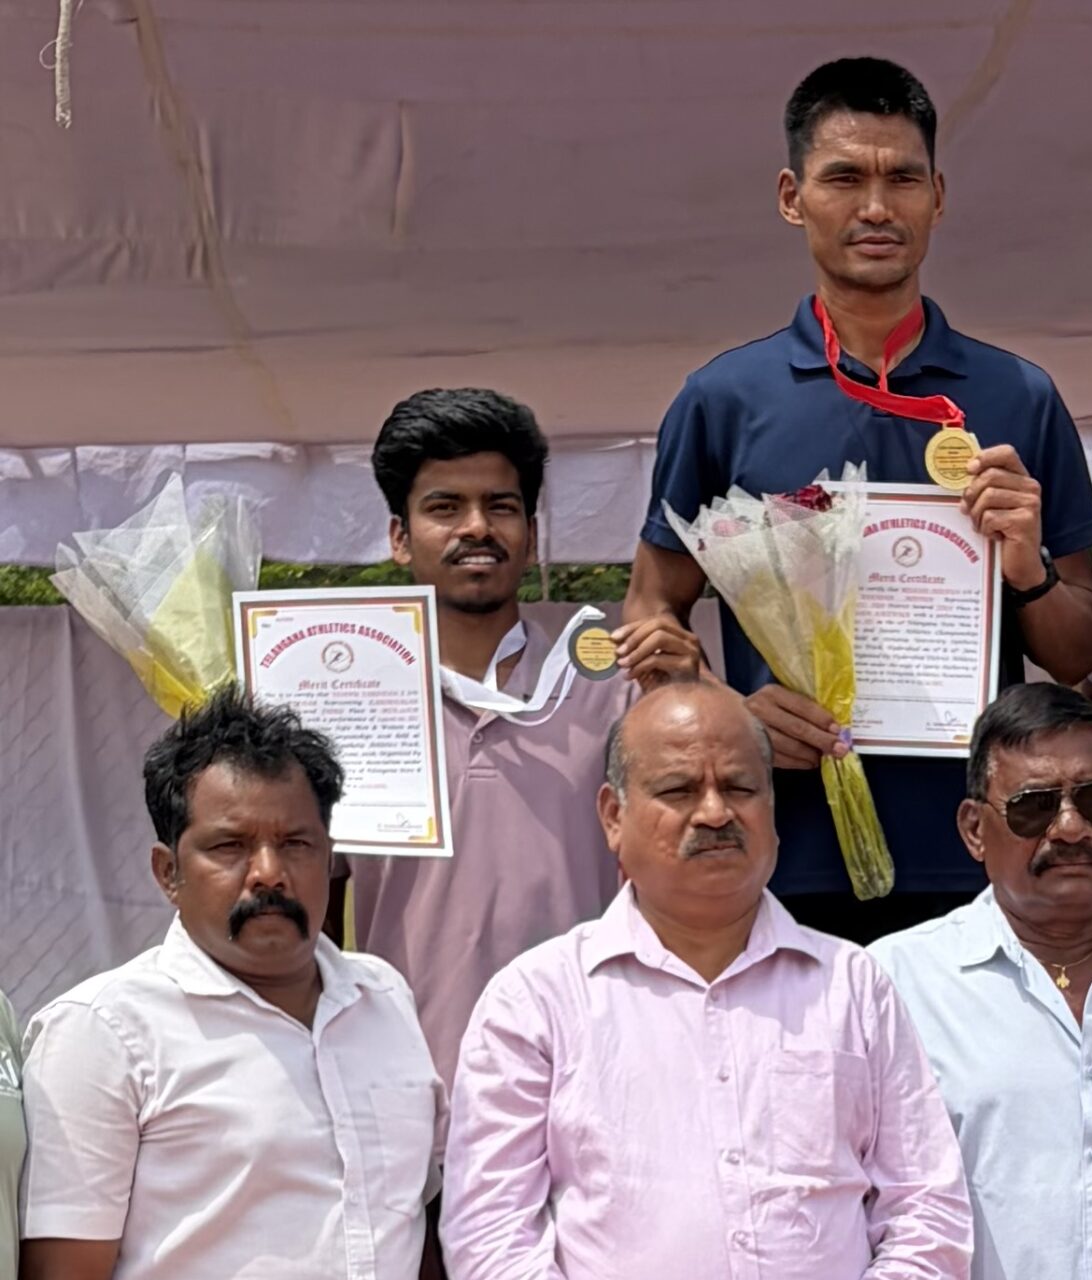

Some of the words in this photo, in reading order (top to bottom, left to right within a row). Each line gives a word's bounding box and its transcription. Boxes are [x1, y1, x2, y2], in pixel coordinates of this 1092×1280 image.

[927, 522, 980, 564] ASSOCIATION
[259, 629, 305, 669] TELANGANA
[306, 622, 356, 637] ATHLETICS
[357, 625, 418, 666] ASSOCIATION
